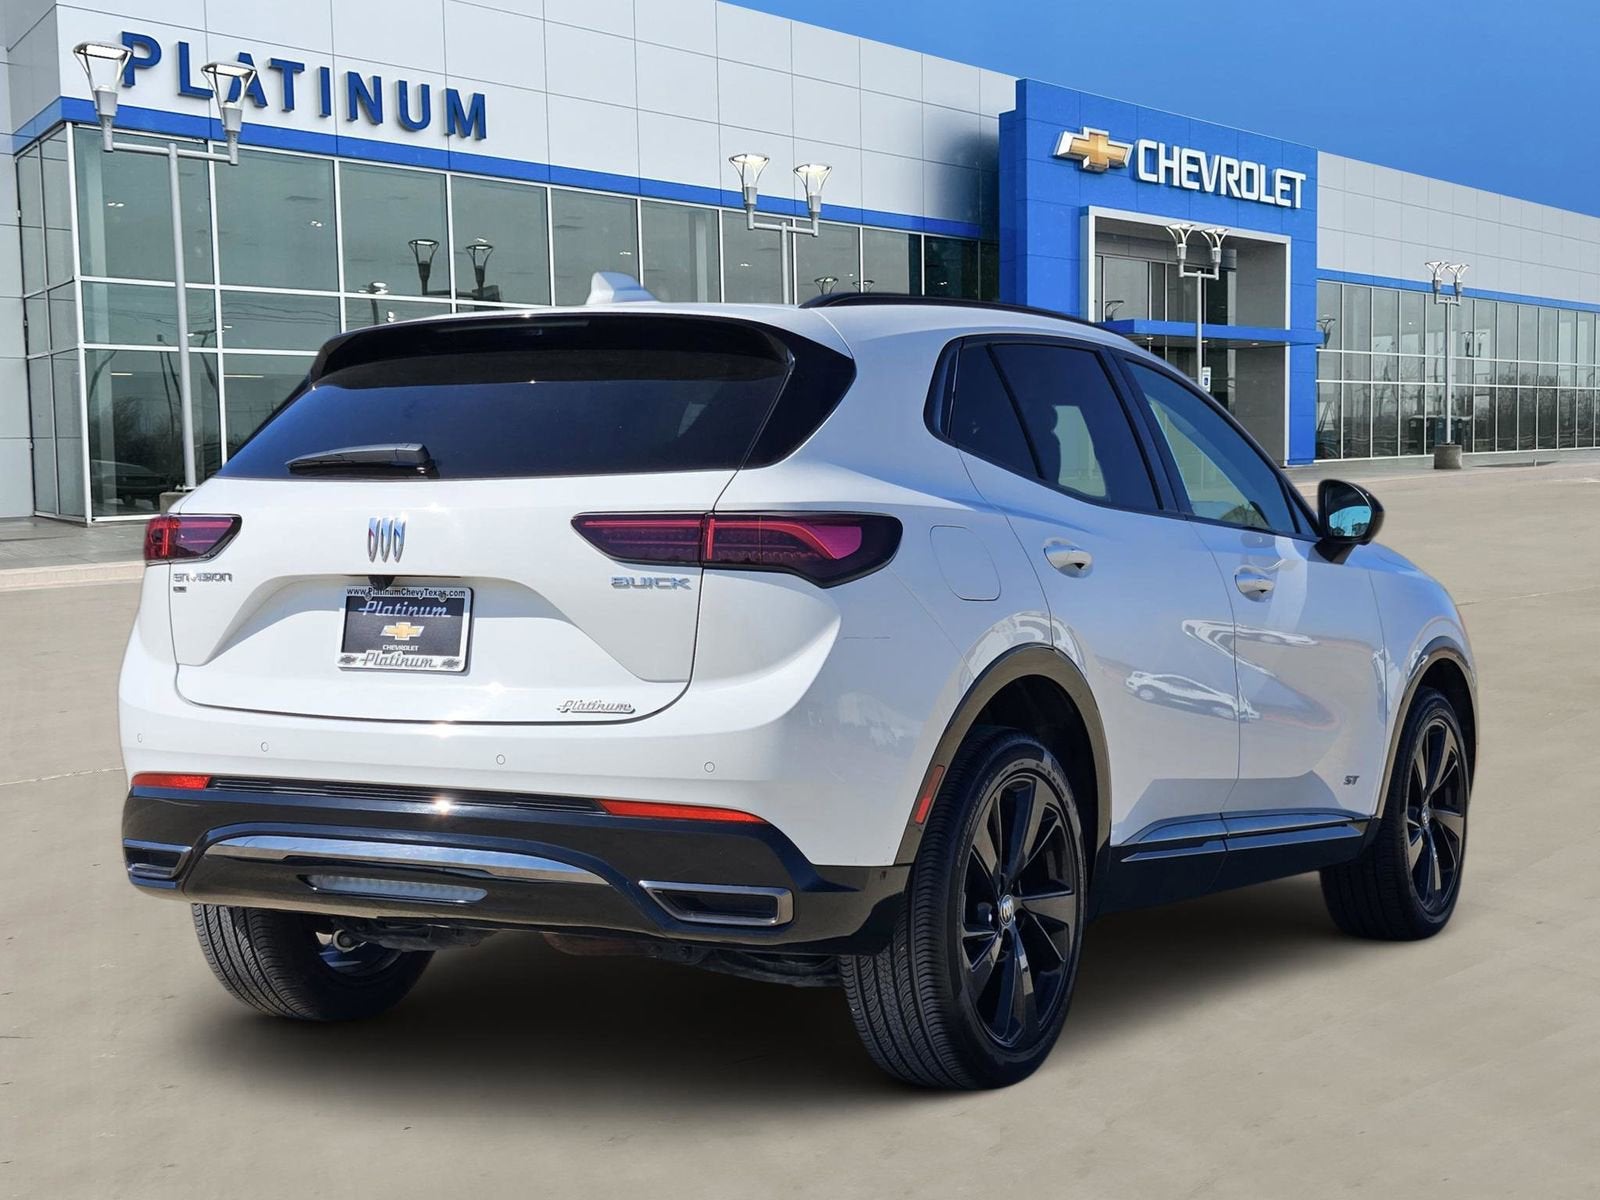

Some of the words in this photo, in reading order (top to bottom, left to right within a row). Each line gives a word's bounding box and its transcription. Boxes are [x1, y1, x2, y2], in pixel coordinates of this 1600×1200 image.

[121, 31, 486, 140] PLATINUM
[1136, 138, 1306, 209] CHEVROLET
[611, 576, 692, 590] BUICK
[346, 587, 466, 598] www.PlatinumChevyTexas.com
[358, 601, 451, 617] Platinum
[360, 652, 438, 668] Platinum
[557, 699, 635, 714] Platinum
[1343, 775, 1360, 785] ST
